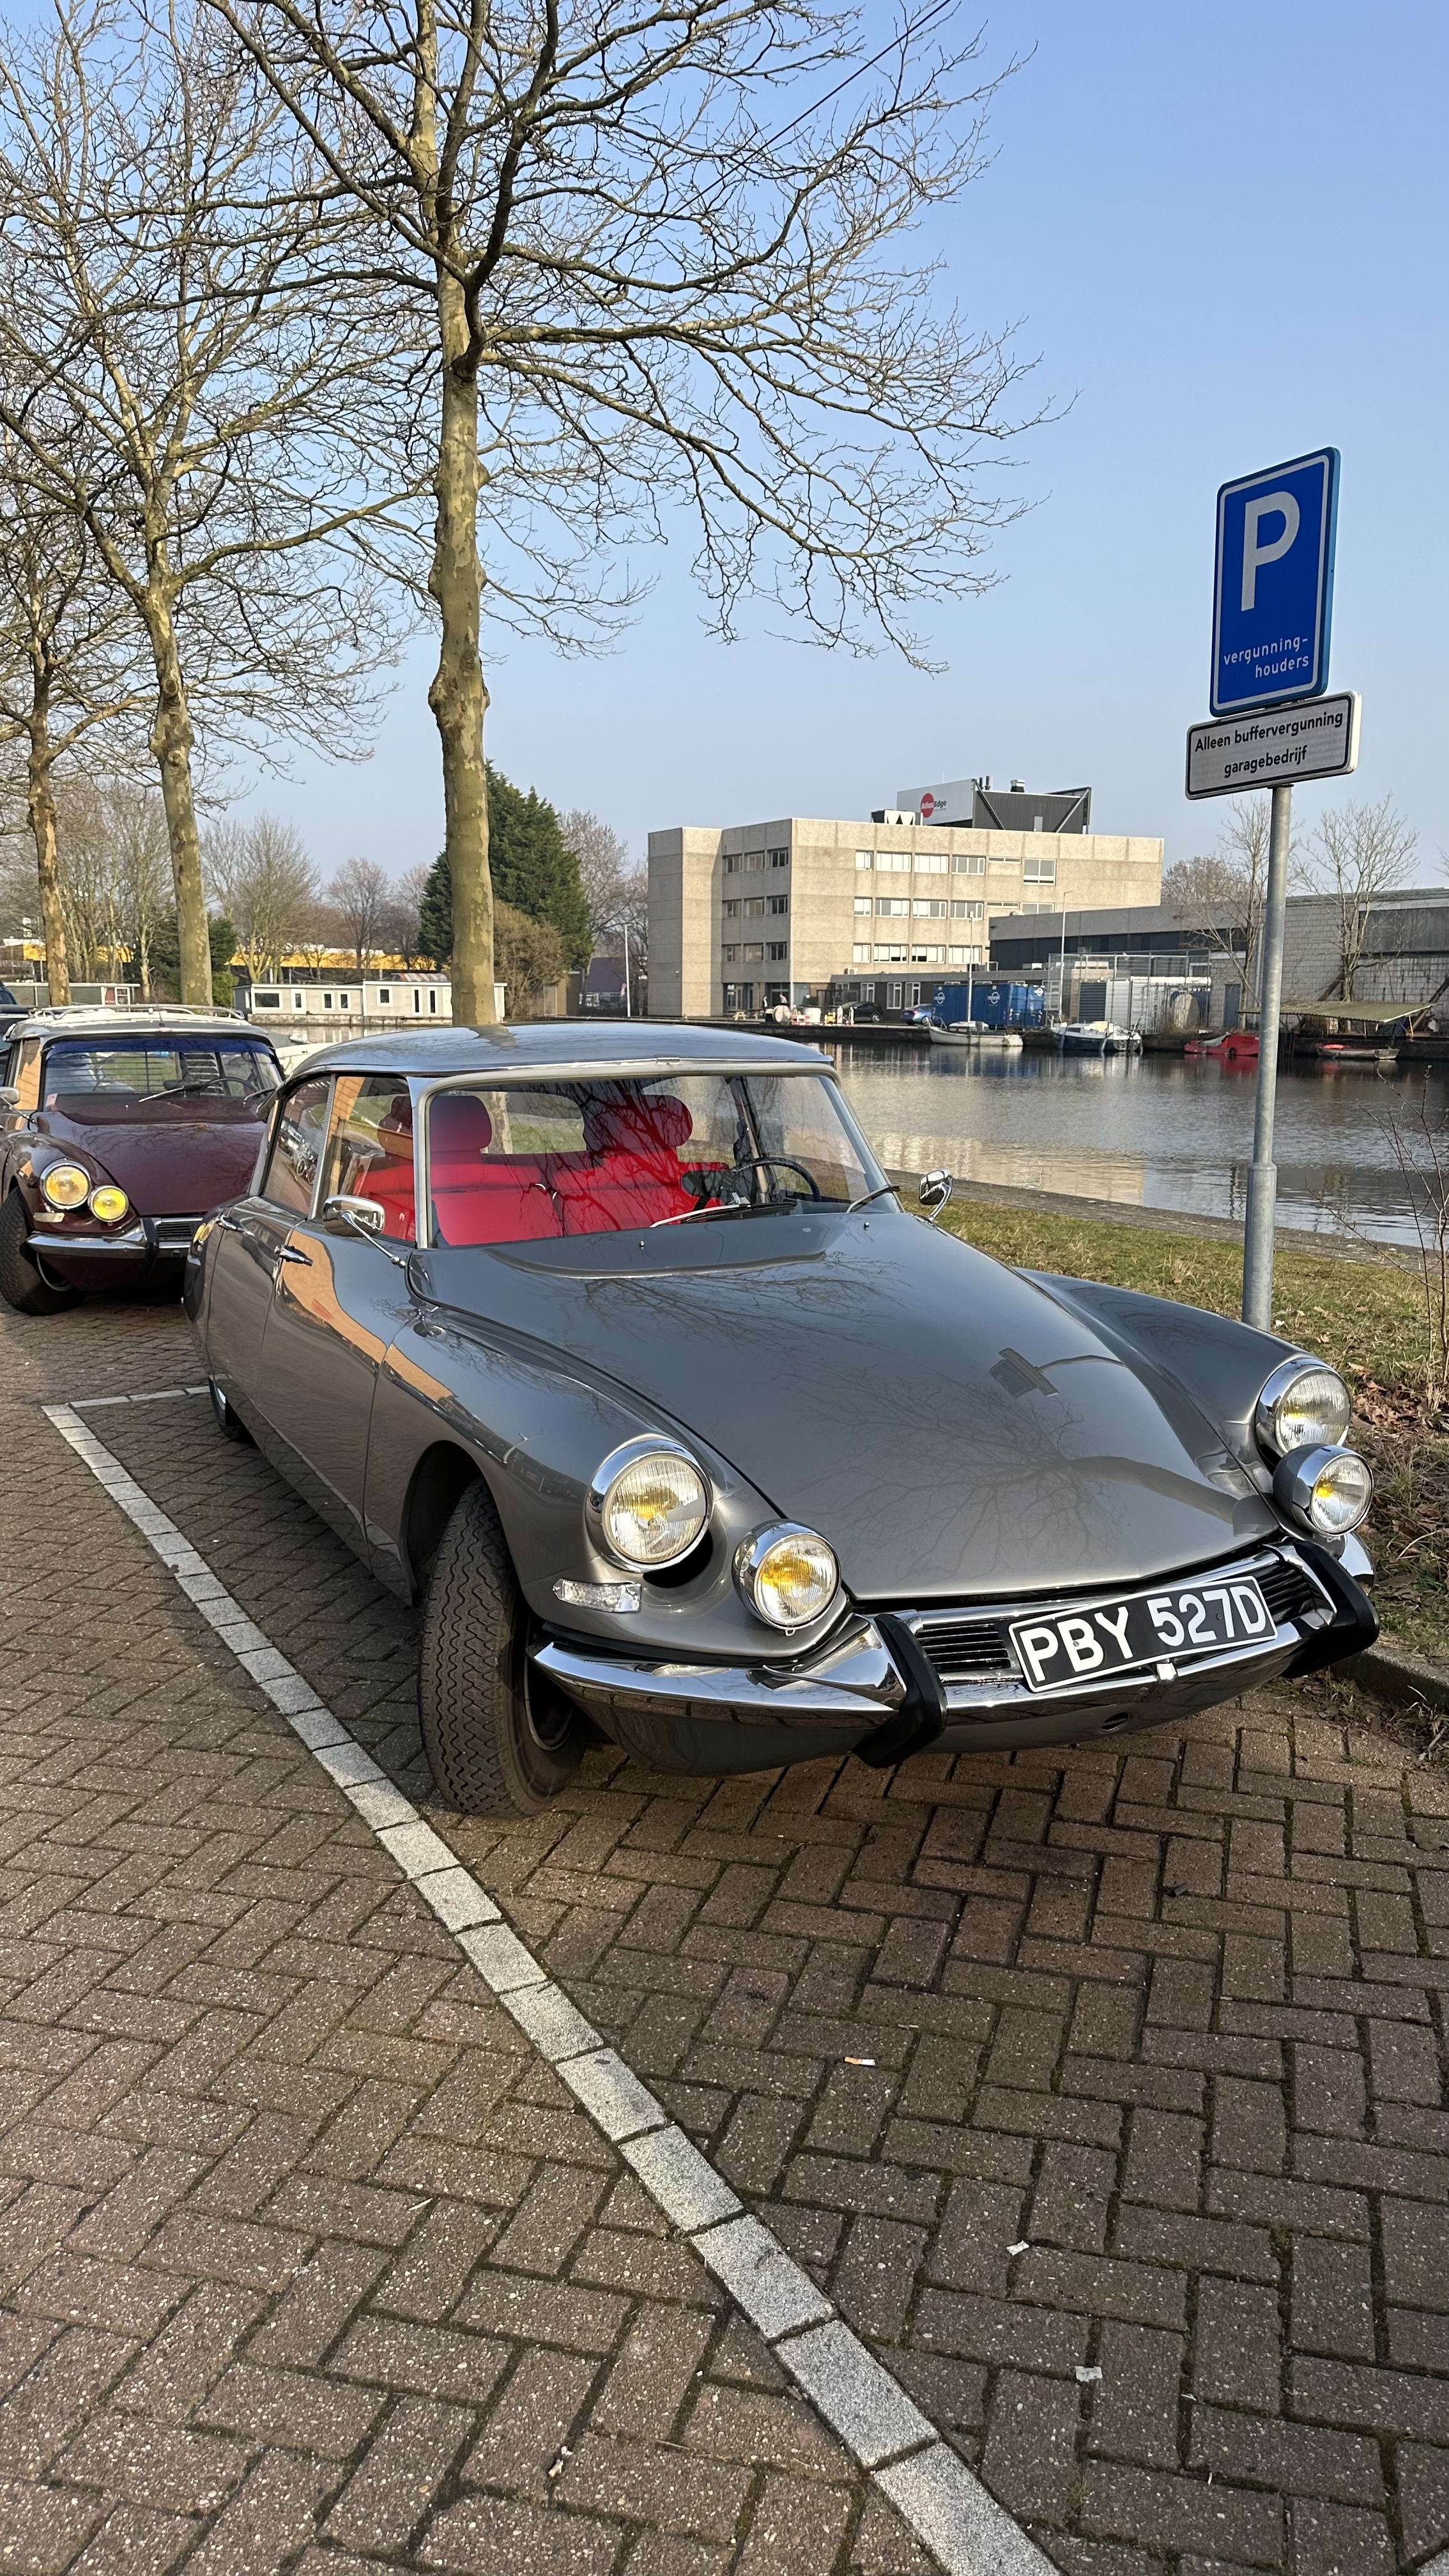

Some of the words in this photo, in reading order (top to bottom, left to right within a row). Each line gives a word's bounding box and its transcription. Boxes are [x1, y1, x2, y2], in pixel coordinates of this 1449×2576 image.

[1241, 491, 1300, 611] P
[1223, 636, 1308, 665] vergunning-
[1255, 656, 1309, 678] houders
[1195, 735, 1230, 752] Alleen
[1234, 711, 1343, 744] buffervergunning
[1224, 744, 1308, 778] garagebedrijf
[1020, 1607, 1133, 1682] PBY
[1147, 1586, 1266, 1646] 527D
